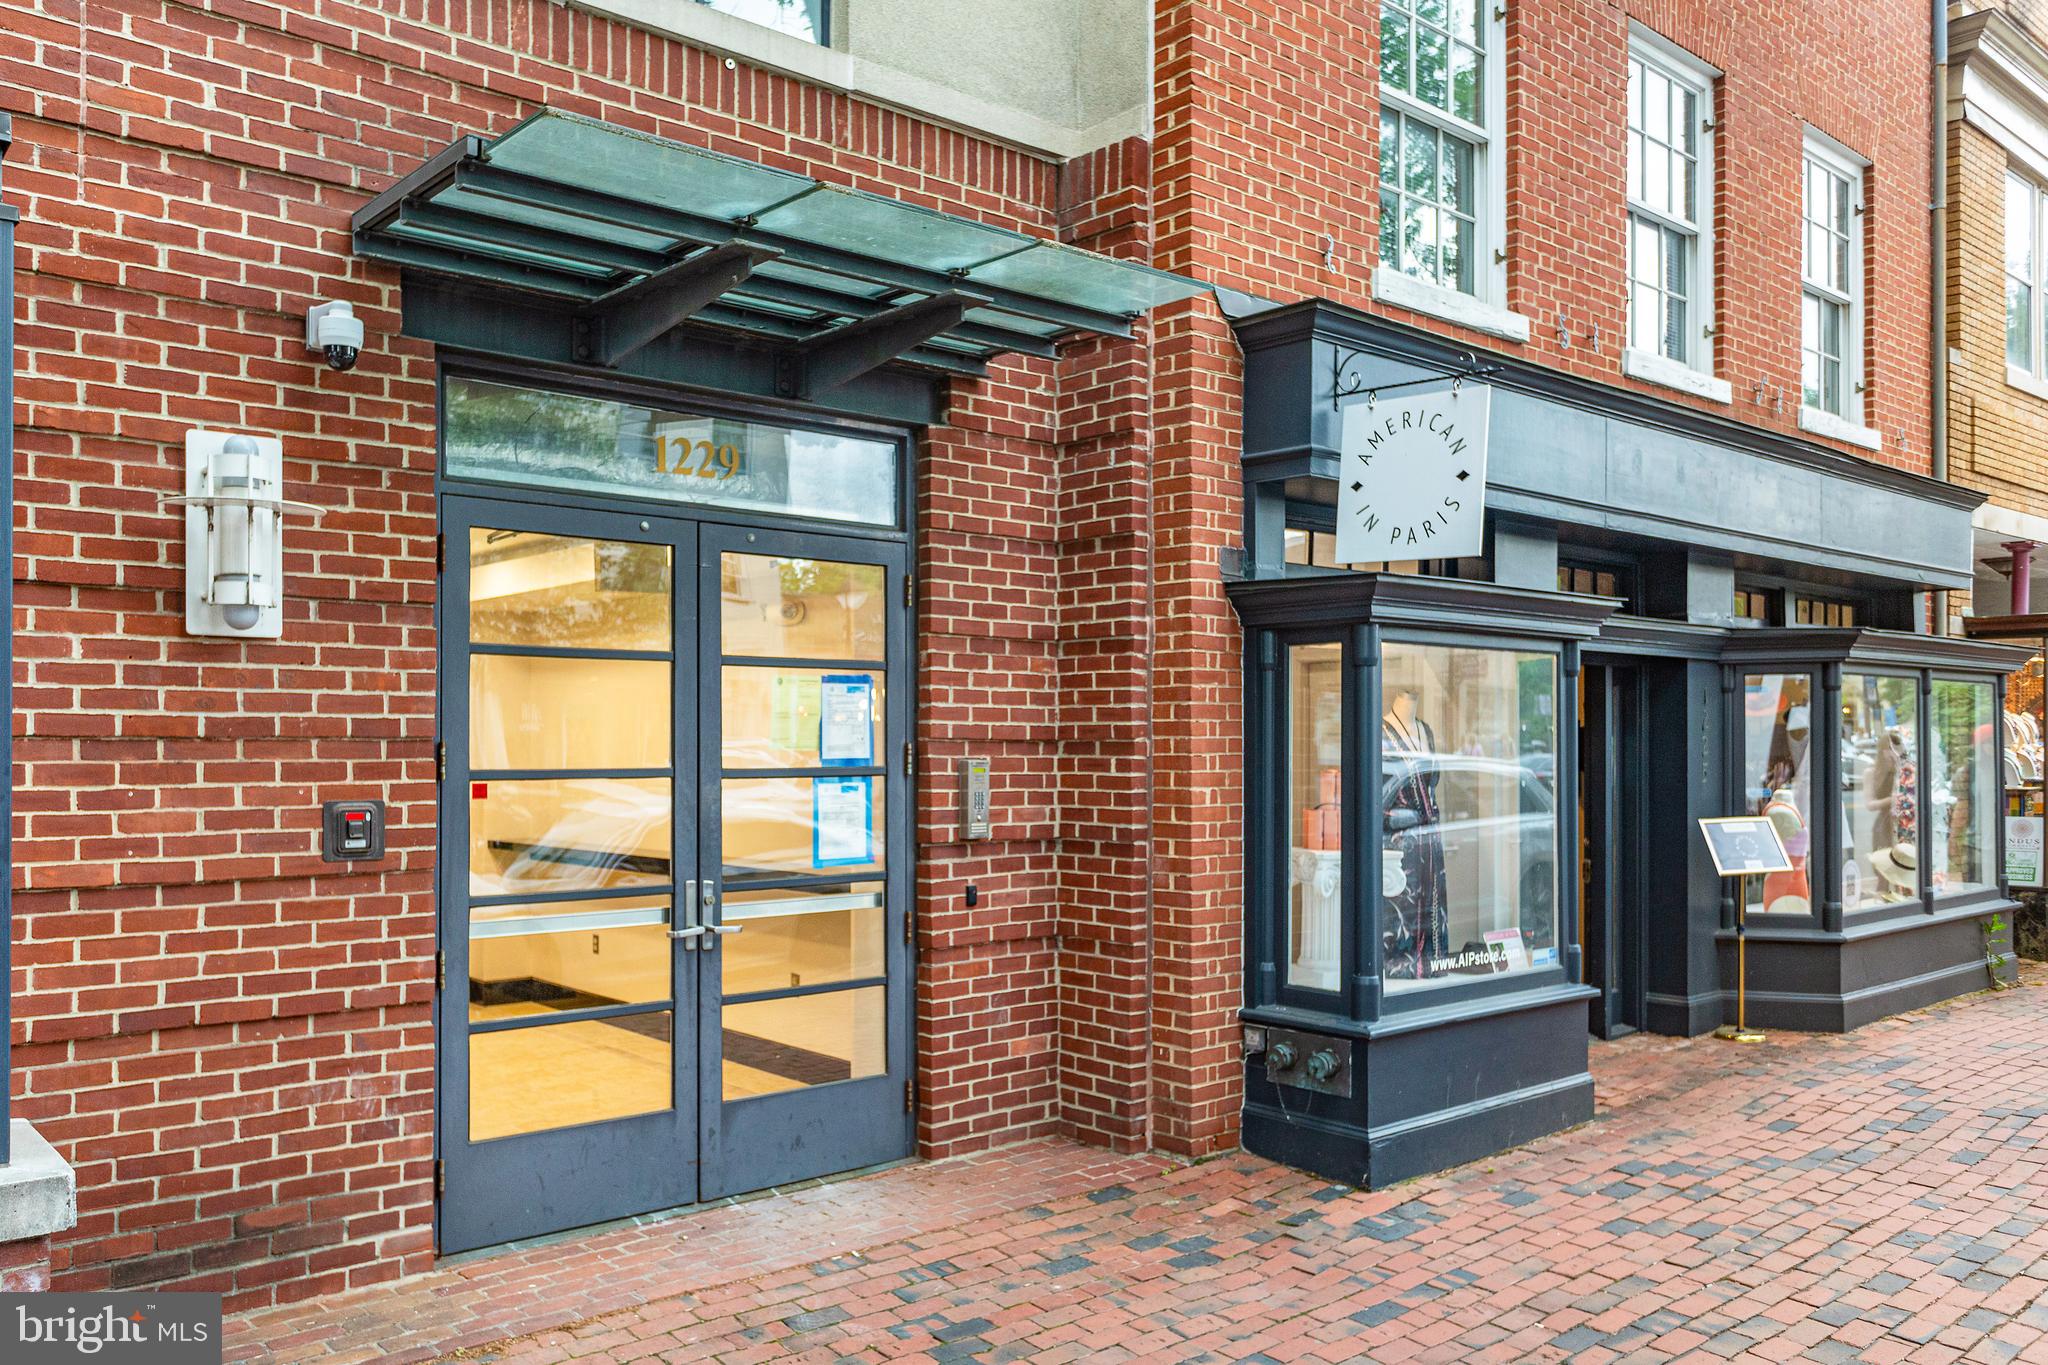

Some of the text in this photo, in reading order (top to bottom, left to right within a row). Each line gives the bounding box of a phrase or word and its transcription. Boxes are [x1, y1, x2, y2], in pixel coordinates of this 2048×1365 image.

[656, 435, 740, 481] 1229
[1356, 410, 1467, 545] AMERICAN IN PARIS
[1430, 949, 1520, 972] www.AIPstore.com
